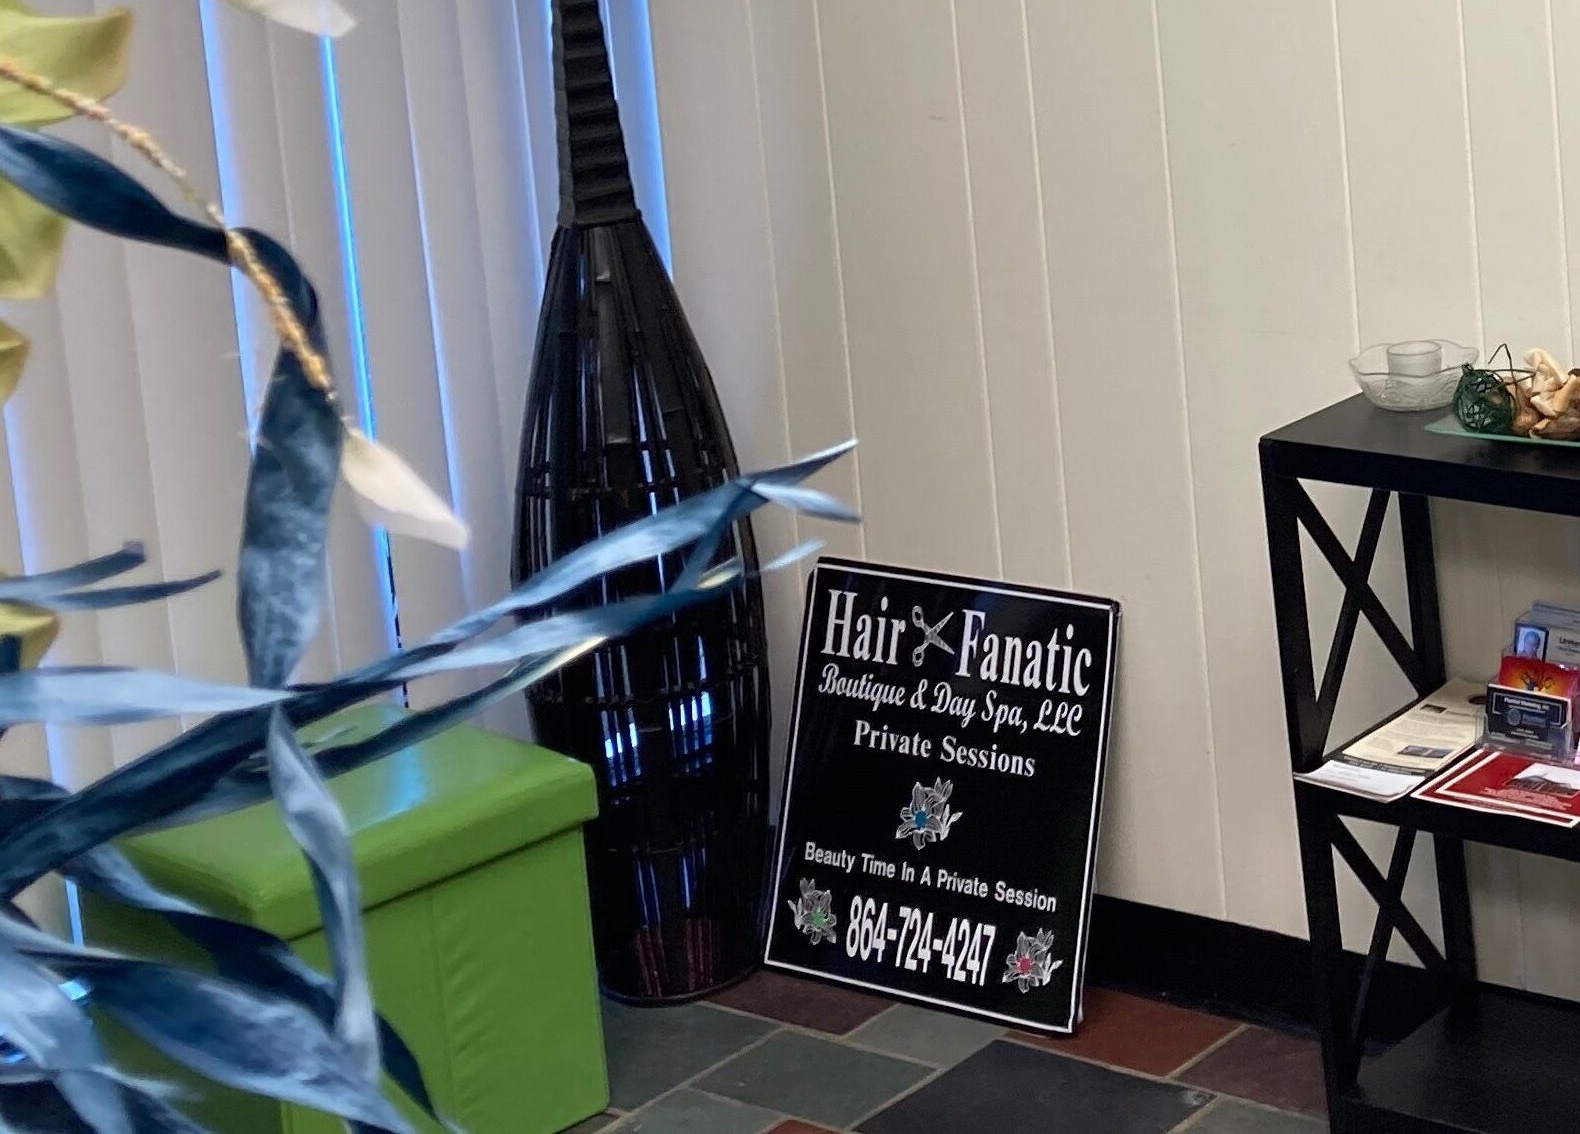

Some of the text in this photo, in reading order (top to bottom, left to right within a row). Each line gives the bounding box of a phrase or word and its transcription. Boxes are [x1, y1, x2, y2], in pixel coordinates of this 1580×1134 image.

[820, 589, 1092, 696] Hair Fanatic
[818, 663, 1083, 737] Boutique & Day Spa, LLC
[853, 720, 1036, 777] Private Sessions
[804, 841, 1057, 912] Beauty Time In A Private Session
[846, 895, 996, 987] 864-724-4247
